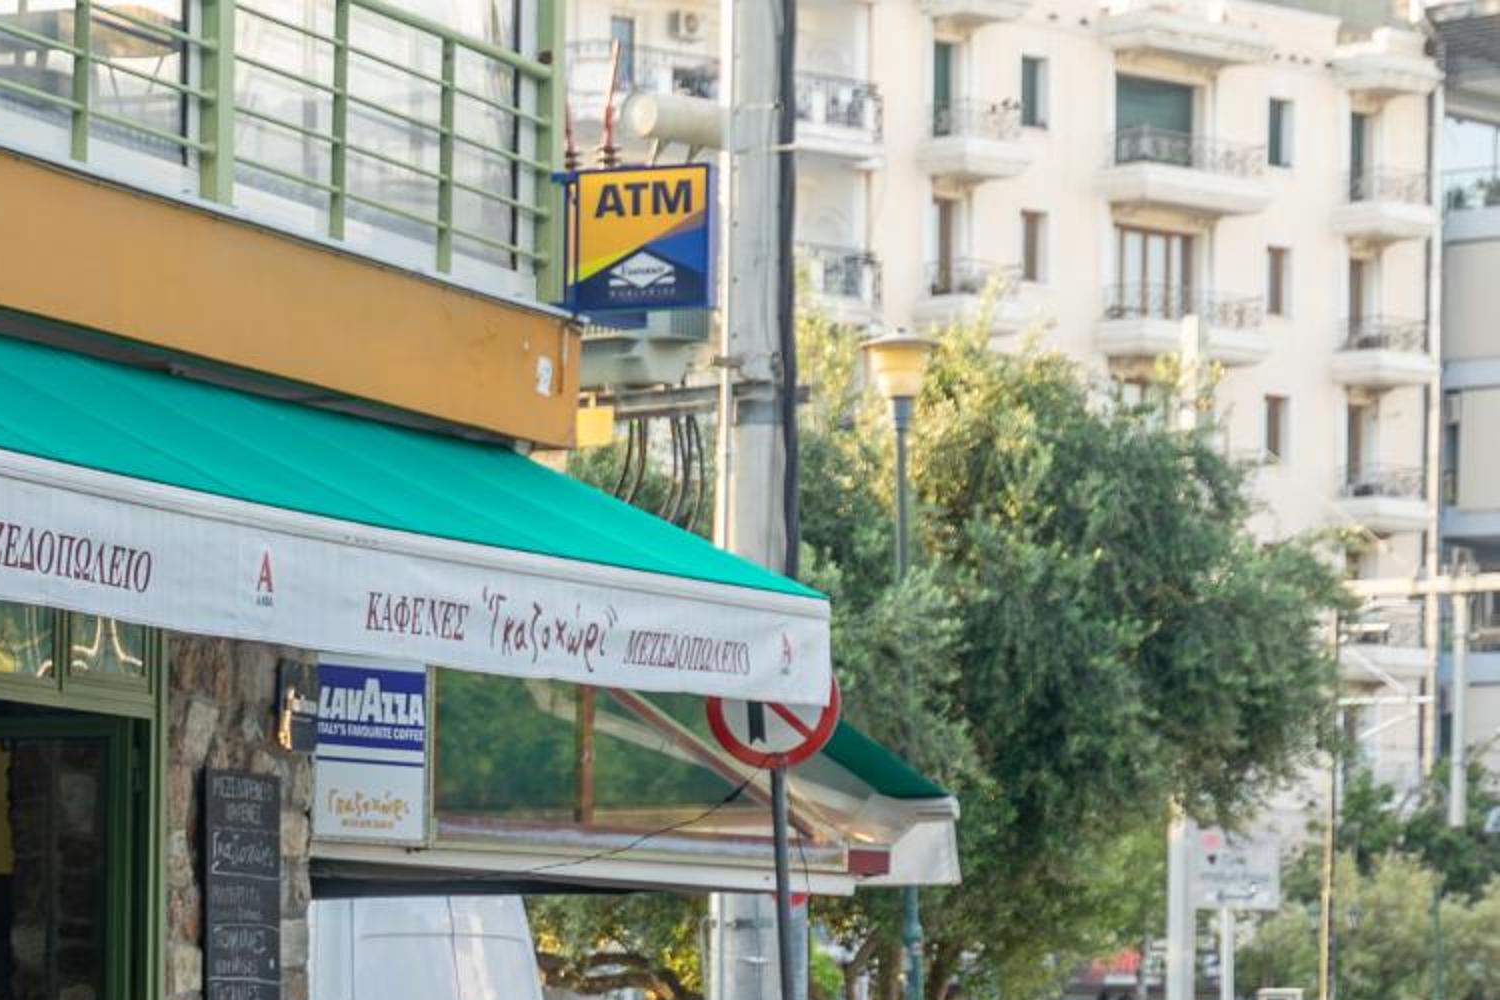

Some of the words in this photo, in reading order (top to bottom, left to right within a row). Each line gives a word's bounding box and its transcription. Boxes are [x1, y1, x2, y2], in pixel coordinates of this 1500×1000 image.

[595, 179, 693, 219] ATM
[366, 591, 470, 641] ΚΑΦΕΝΕΣ
[623, 629, 751, 675] ΜΕΖΕΔΟΠΩΛΕΙΟ
[317, 677, 425, 727] LAVAZZA
